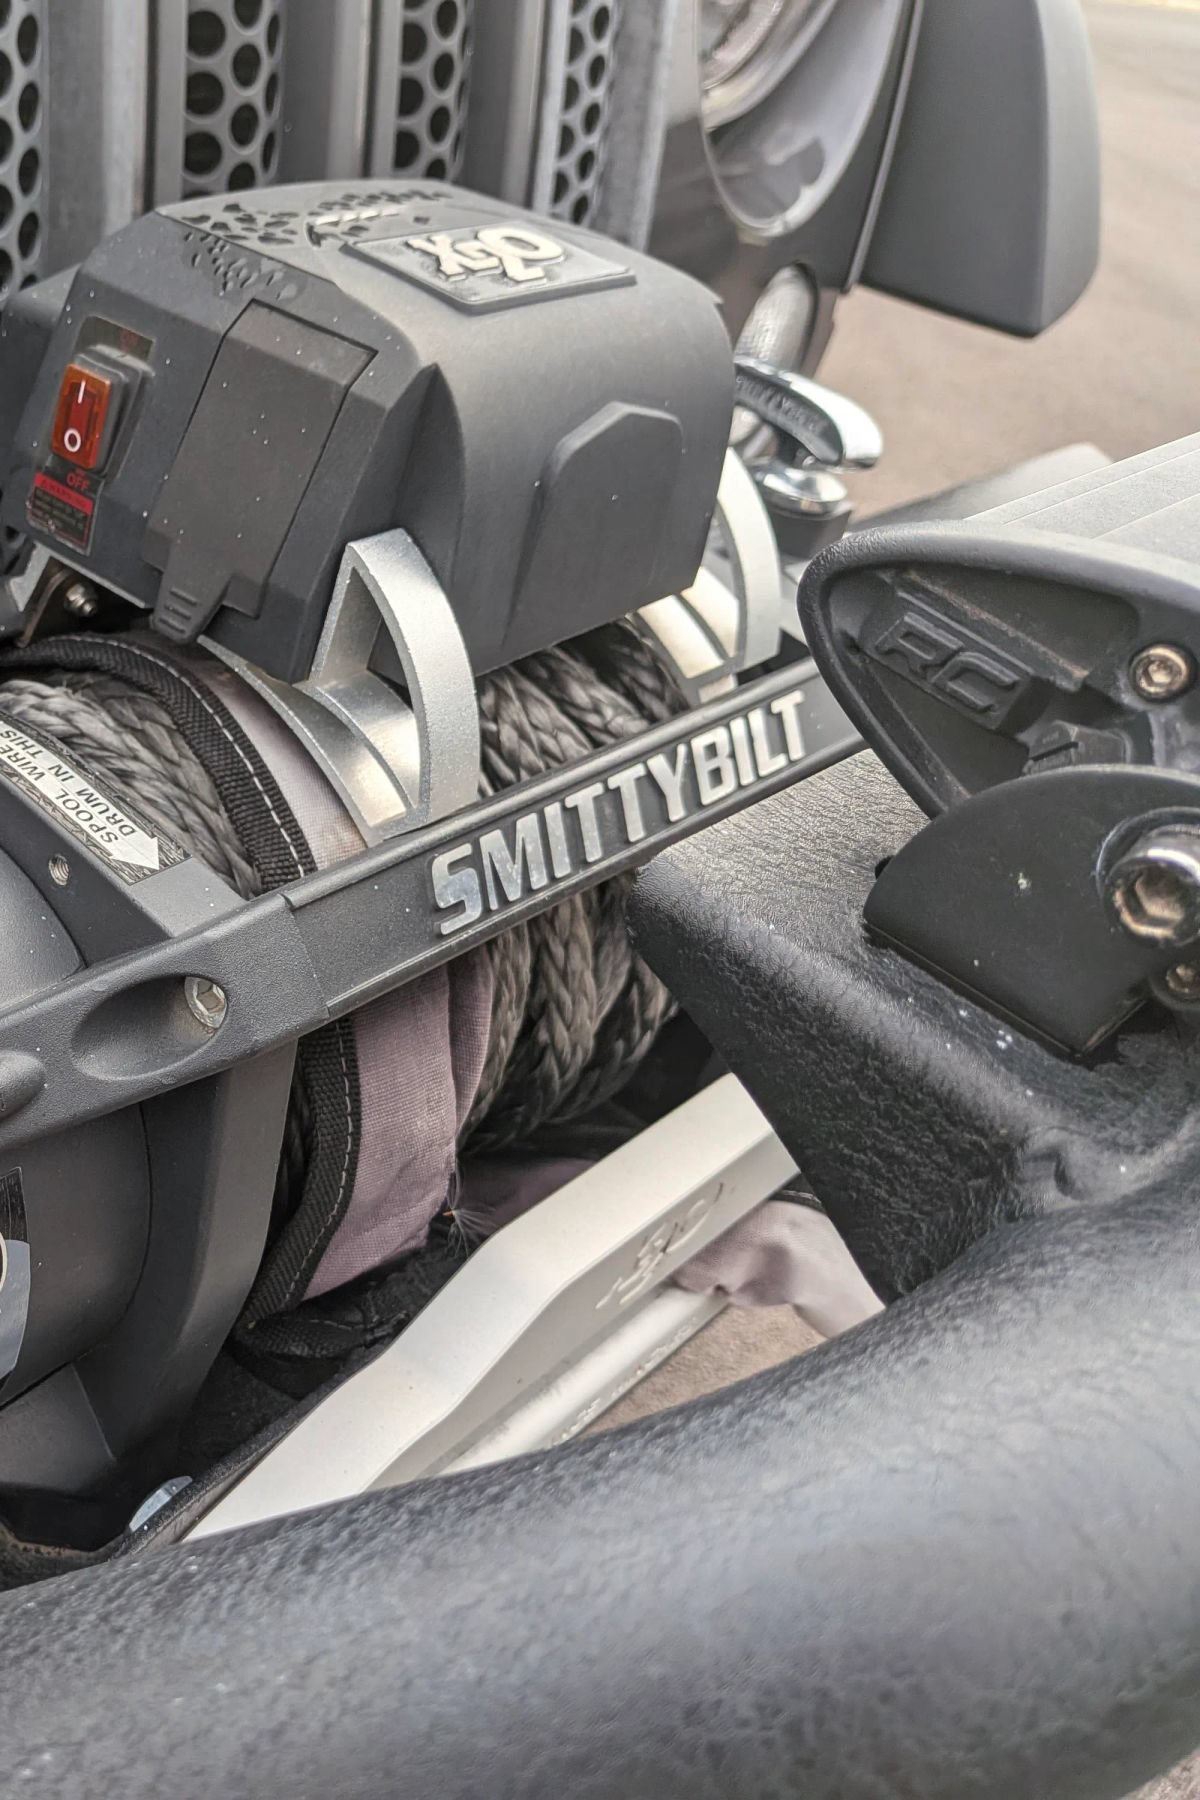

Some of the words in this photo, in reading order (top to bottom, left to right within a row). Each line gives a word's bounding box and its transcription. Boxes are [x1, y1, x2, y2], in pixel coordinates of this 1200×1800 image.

[66, 471, 90, 491] OFF
[0, 730, 43, 759] THIS
[48, 763, 75, 782] IN
[55, 788, 119, 843] SPOOL
[75, 788, 137, 837] DRUM
[431, 690, 806, 936] SMITTYBILT
